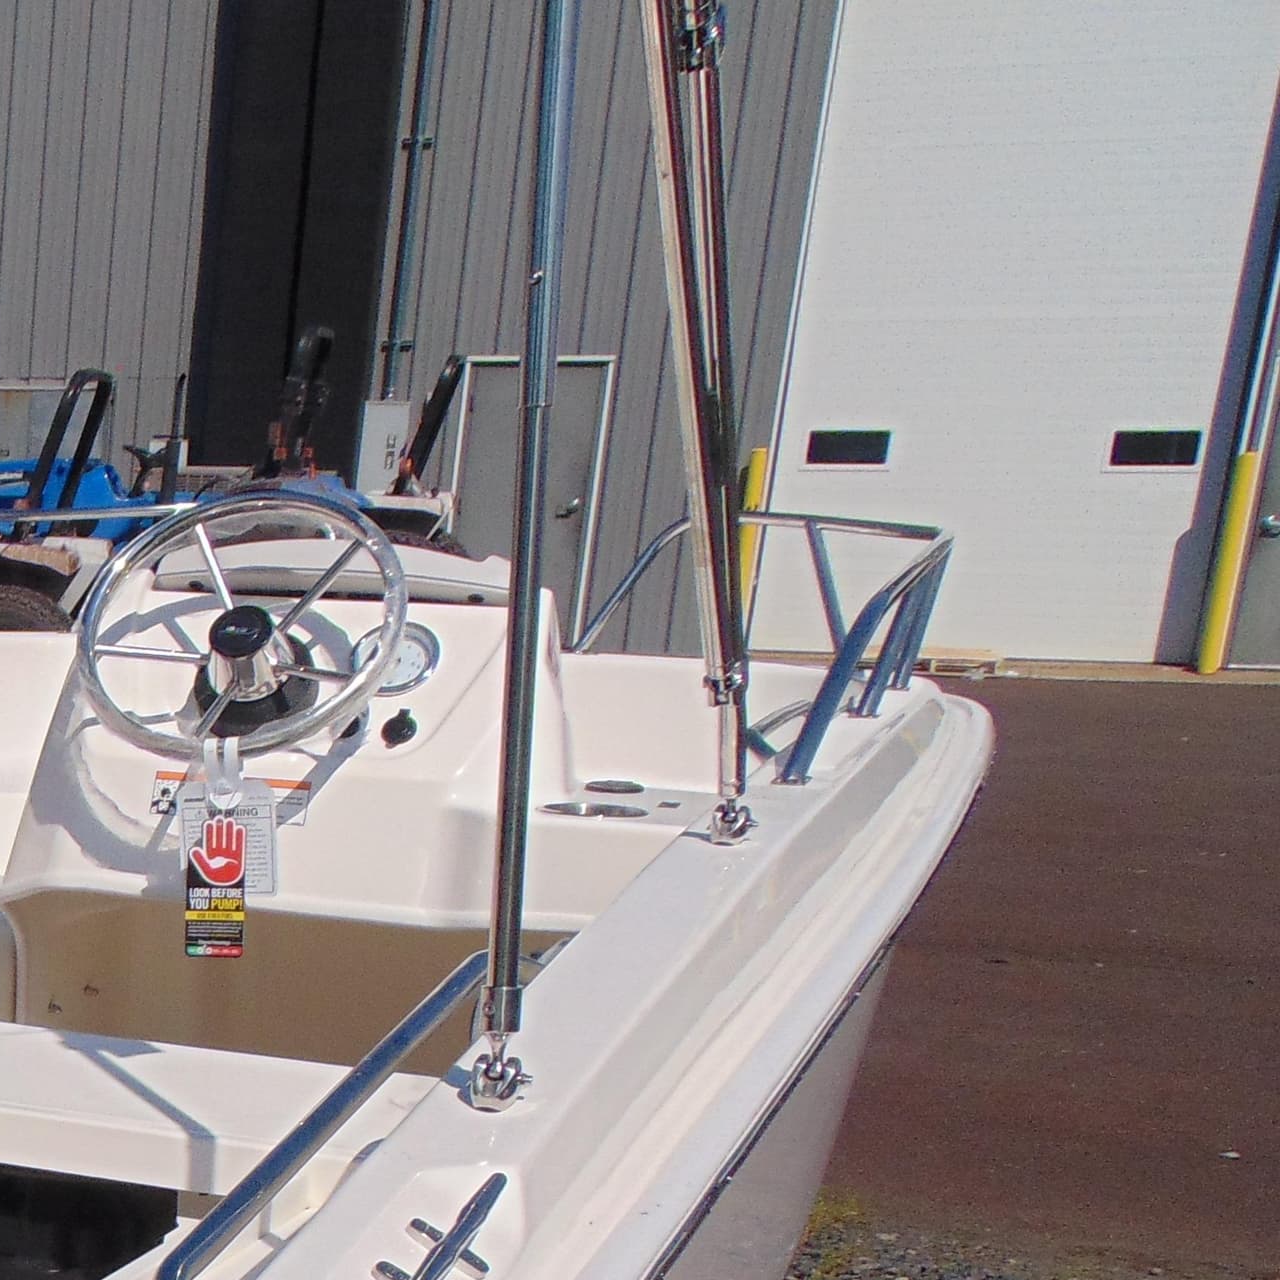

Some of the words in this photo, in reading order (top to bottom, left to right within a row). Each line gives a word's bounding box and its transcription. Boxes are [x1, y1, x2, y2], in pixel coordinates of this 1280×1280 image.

[188, 887, 210, 898] LOOK
[211, 887, 243, 898] BEFORE
[189, 898, 209, 910] YOU
[211, 898, 243, 910] PUMP!
